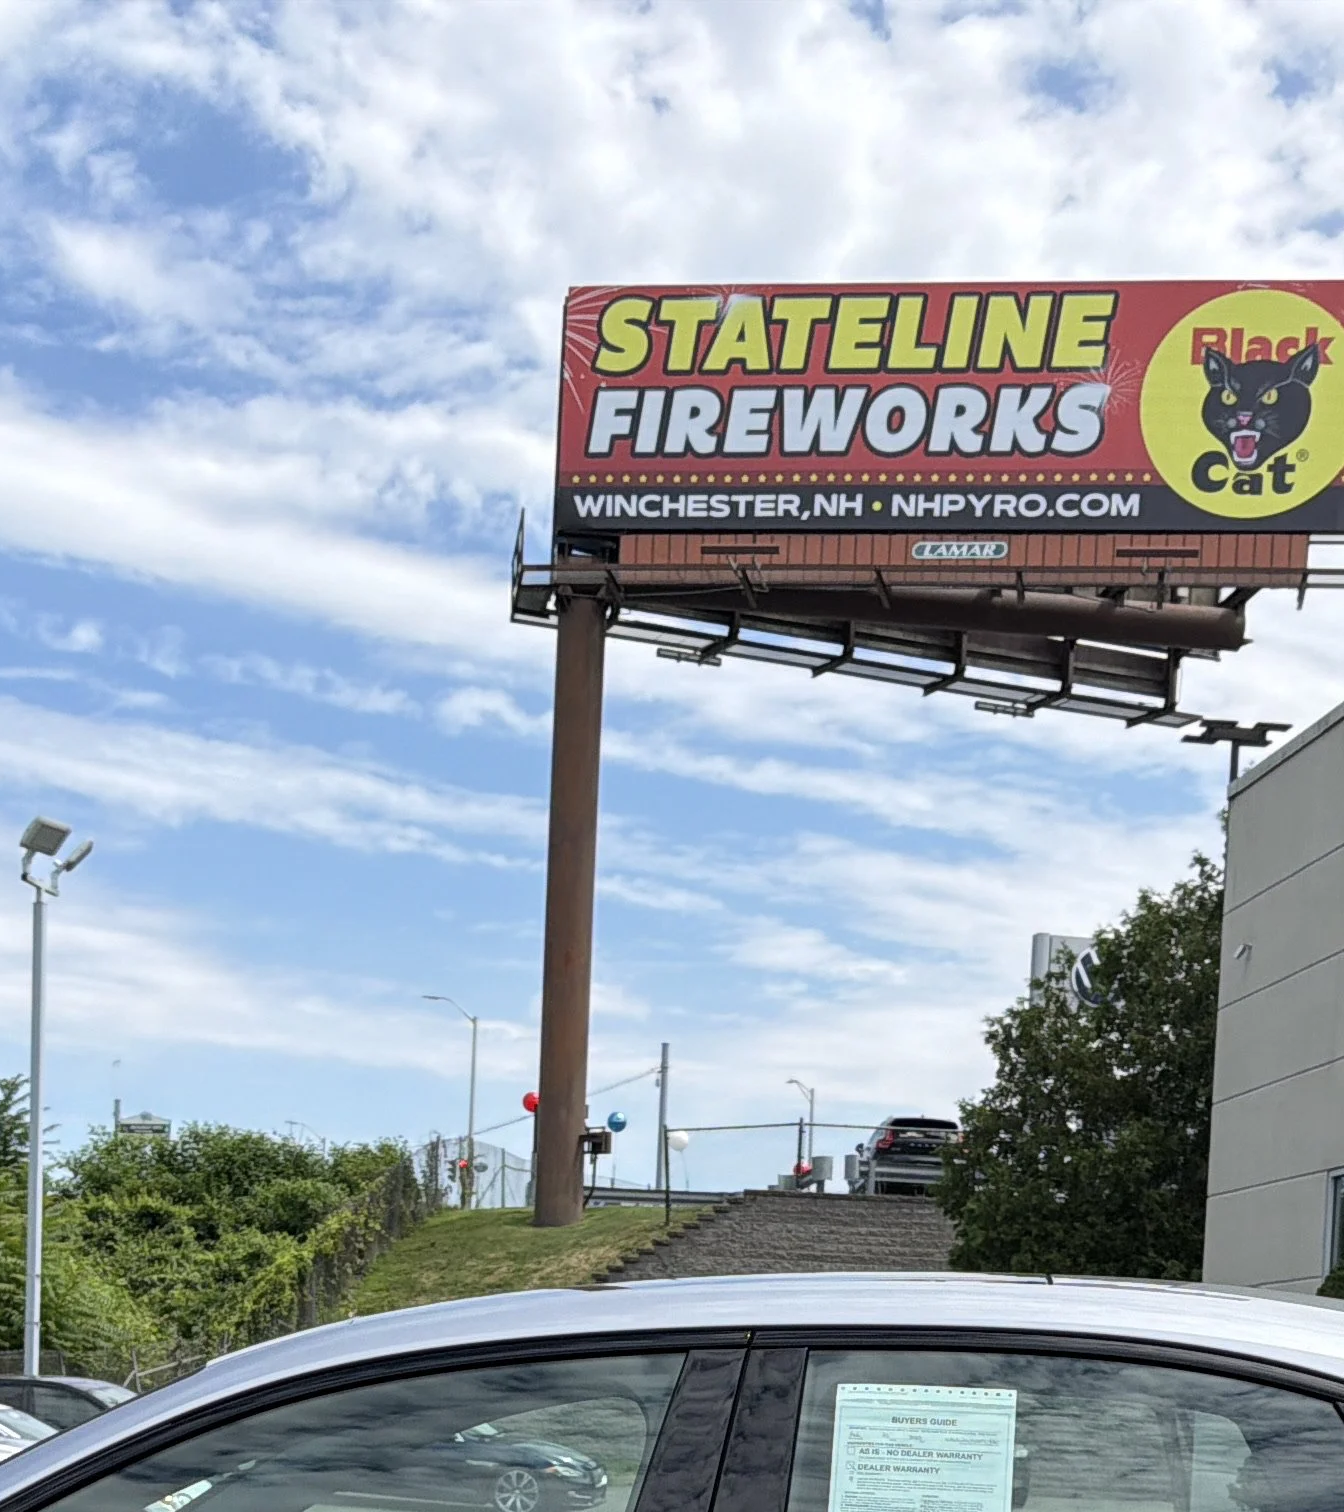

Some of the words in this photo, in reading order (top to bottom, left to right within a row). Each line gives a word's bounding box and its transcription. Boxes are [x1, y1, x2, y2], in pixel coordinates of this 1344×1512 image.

[592, 292, 1118, 376] STATELINE
[1190, 326, 1336, 366] Black
[585, 384, 1111, 457] FIREWORKS
[891, 493, 1140, 518] NHPYRO.COM
[924, 543, 997, 557] LAMAR
[891, 1416, 927, 1425] BUYERS
[930, 1418, 958, 1427] GUIDE
[859, 1447, 870, 1455] AS
[872, 1448, 880, 1456] IS
[886, 1449, 900, 1457] NO
[901, 1449, 934, 1458] DEALER
[936, 1451, 983, 1461] WARRANTY
[857, 1463, 891, 1472] DEALER
[893, 1465, 940, 1475] WARRANTY
